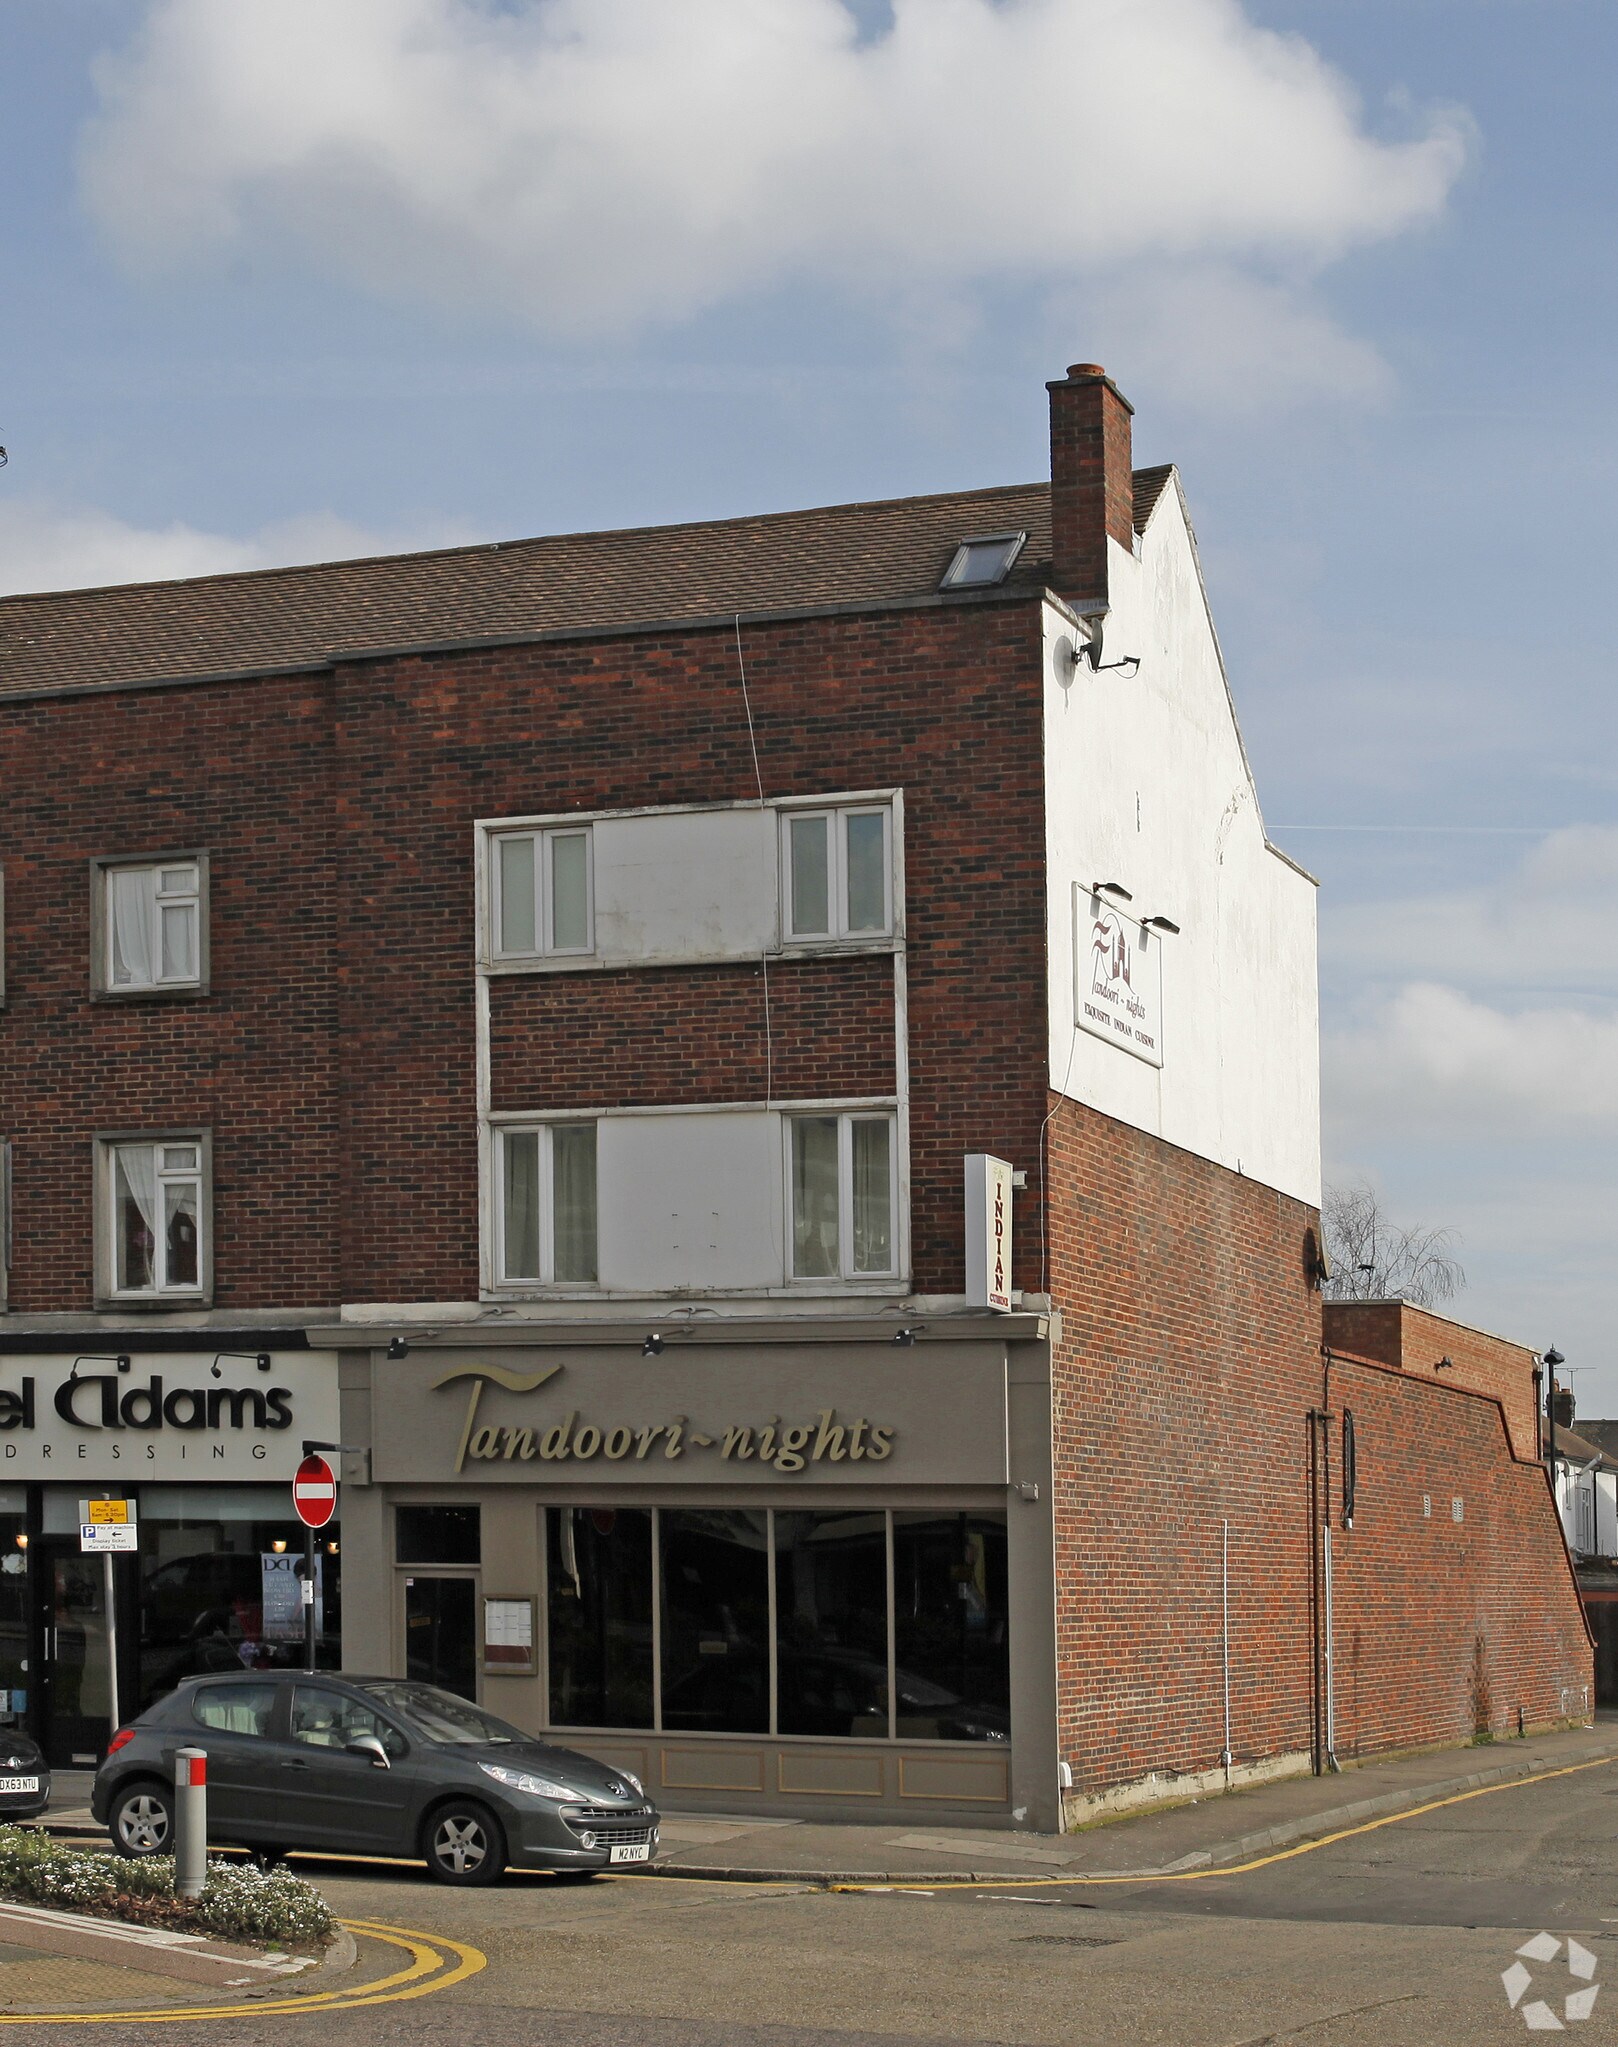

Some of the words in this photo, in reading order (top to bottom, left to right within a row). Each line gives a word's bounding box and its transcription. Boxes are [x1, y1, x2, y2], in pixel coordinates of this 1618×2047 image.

[1083, 1001, 1112, 1027] EXQUISITE
[1113, 1017, 1133, 1038] INDIAN
[1135, 1029, 1156, 1050] CUISINE
[994, 1182, 1004, 1292] INDIAN
[5, 1444, 267, 1459] DRESSING
[629, 1847, 643, 1859] NYC
